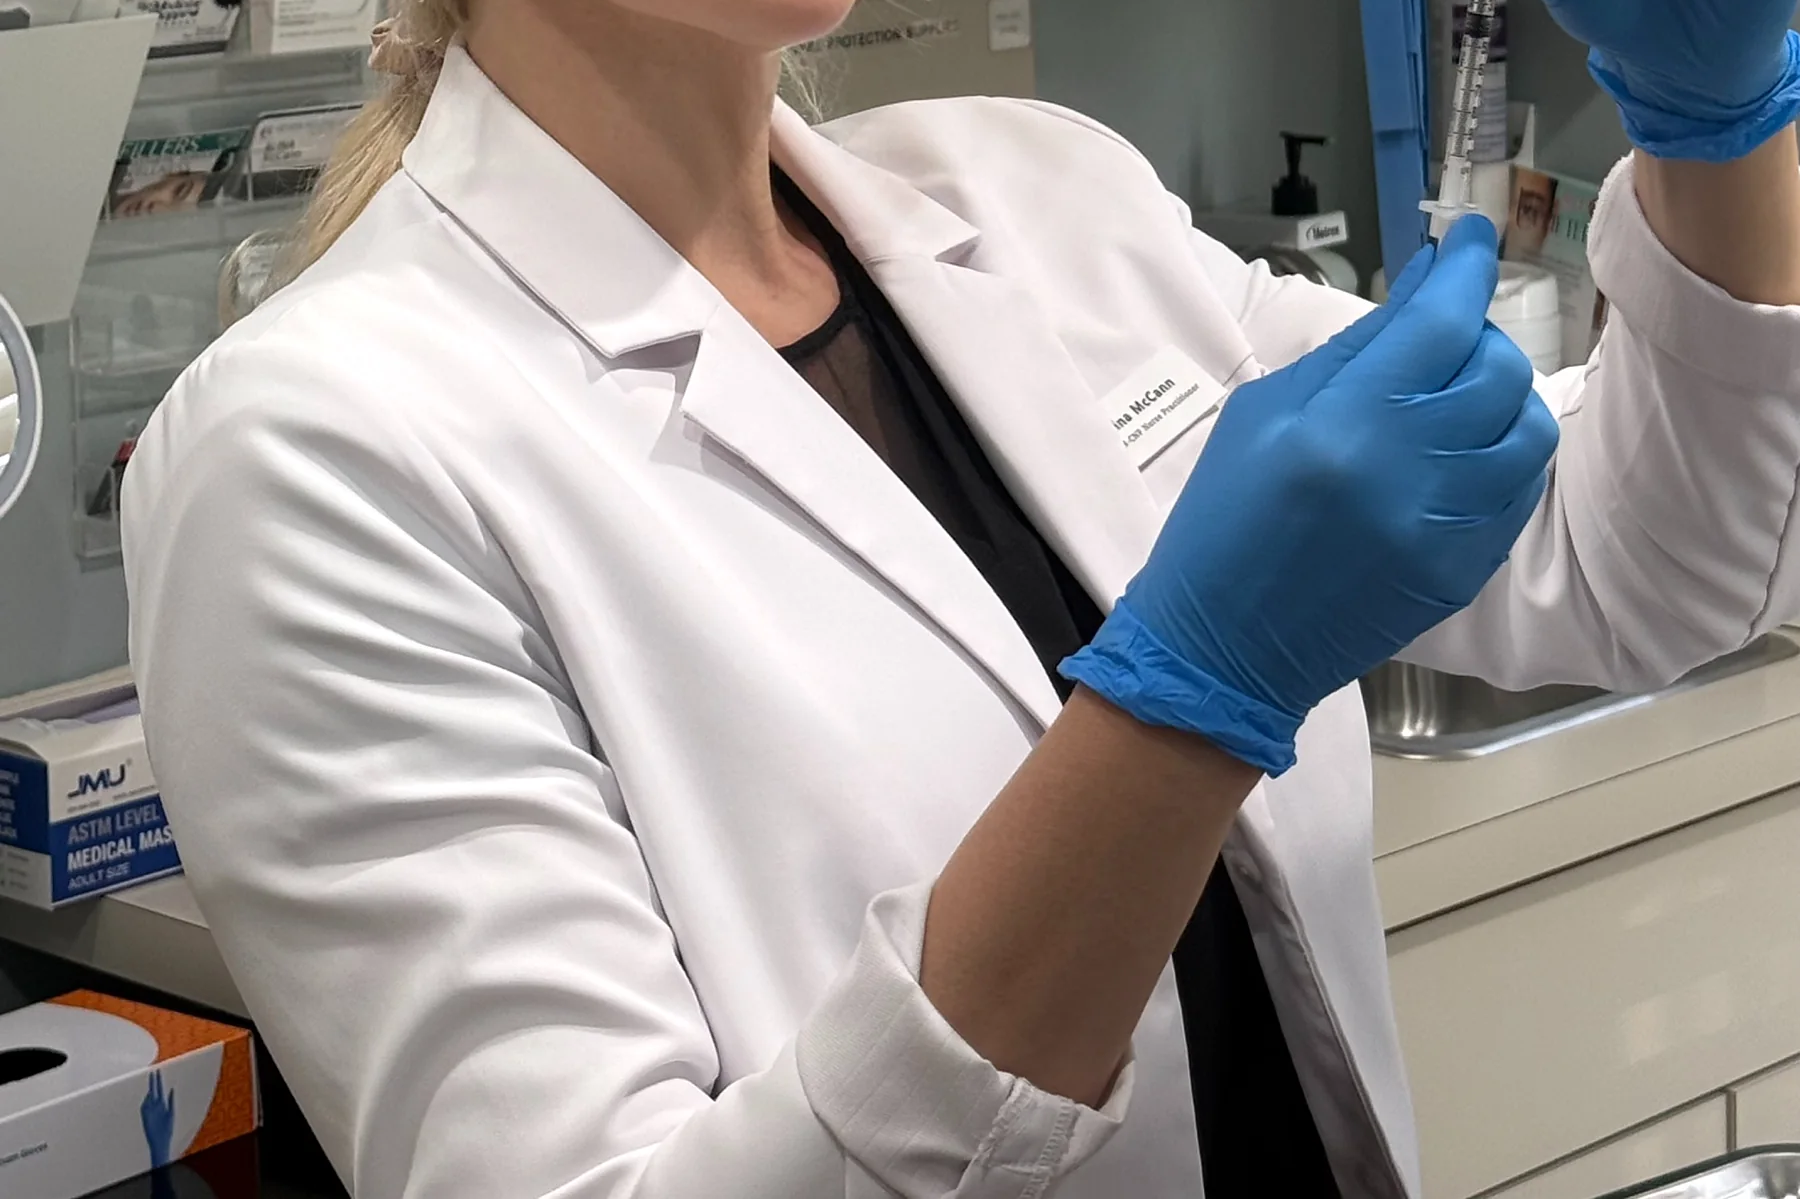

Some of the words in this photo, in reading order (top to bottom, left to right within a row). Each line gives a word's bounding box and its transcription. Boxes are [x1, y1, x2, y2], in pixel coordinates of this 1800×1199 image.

[827, 28, 902, 49] PROTECTION
[118, 137, 200, 160] FILLERS
[1129, 378, 1176, 415] McCann
[1141, 413, 1163, 432] Nurse
[1161, 383, 1200, 416] Practitioner
[67, 764, 125, 799] JMU
[68, 816, 113, 845] ASTM
[115, 803, 160, 831] LEVEL
[67, 836, 136, 873] MEDICAL
[139, 826, 173, 851] MAS
[68, 869, 104, 890] ADULT
[105, 862, 131, 879] SIZE
